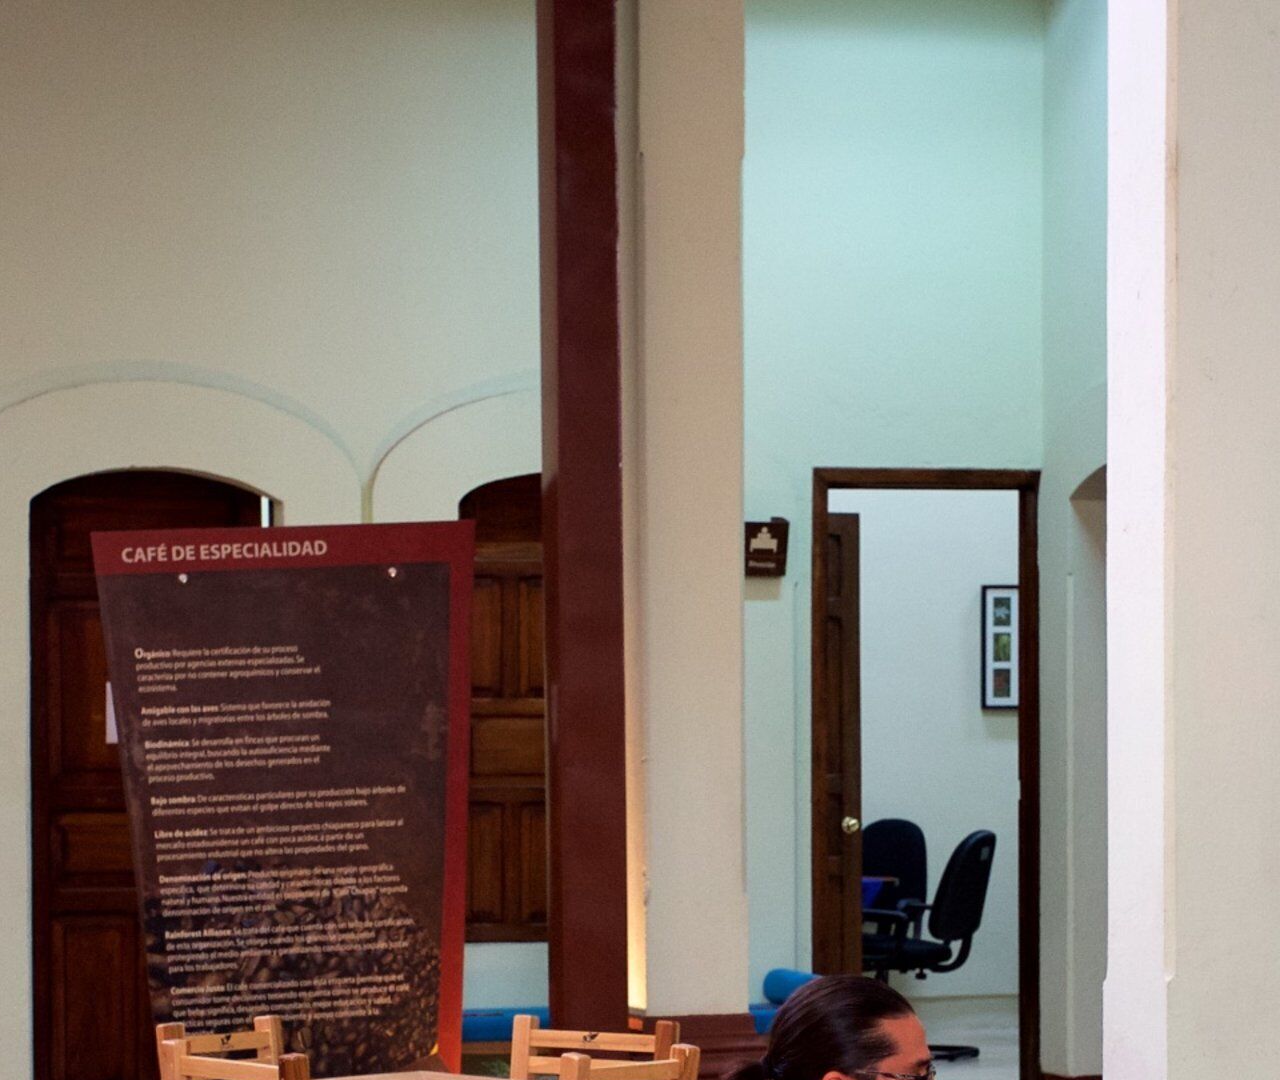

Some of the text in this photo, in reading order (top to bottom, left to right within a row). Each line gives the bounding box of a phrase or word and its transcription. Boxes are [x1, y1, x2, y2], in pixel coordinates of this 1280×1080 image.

[121, 540, 328, 563] CAFÉ DE ESPECIALIDAD
